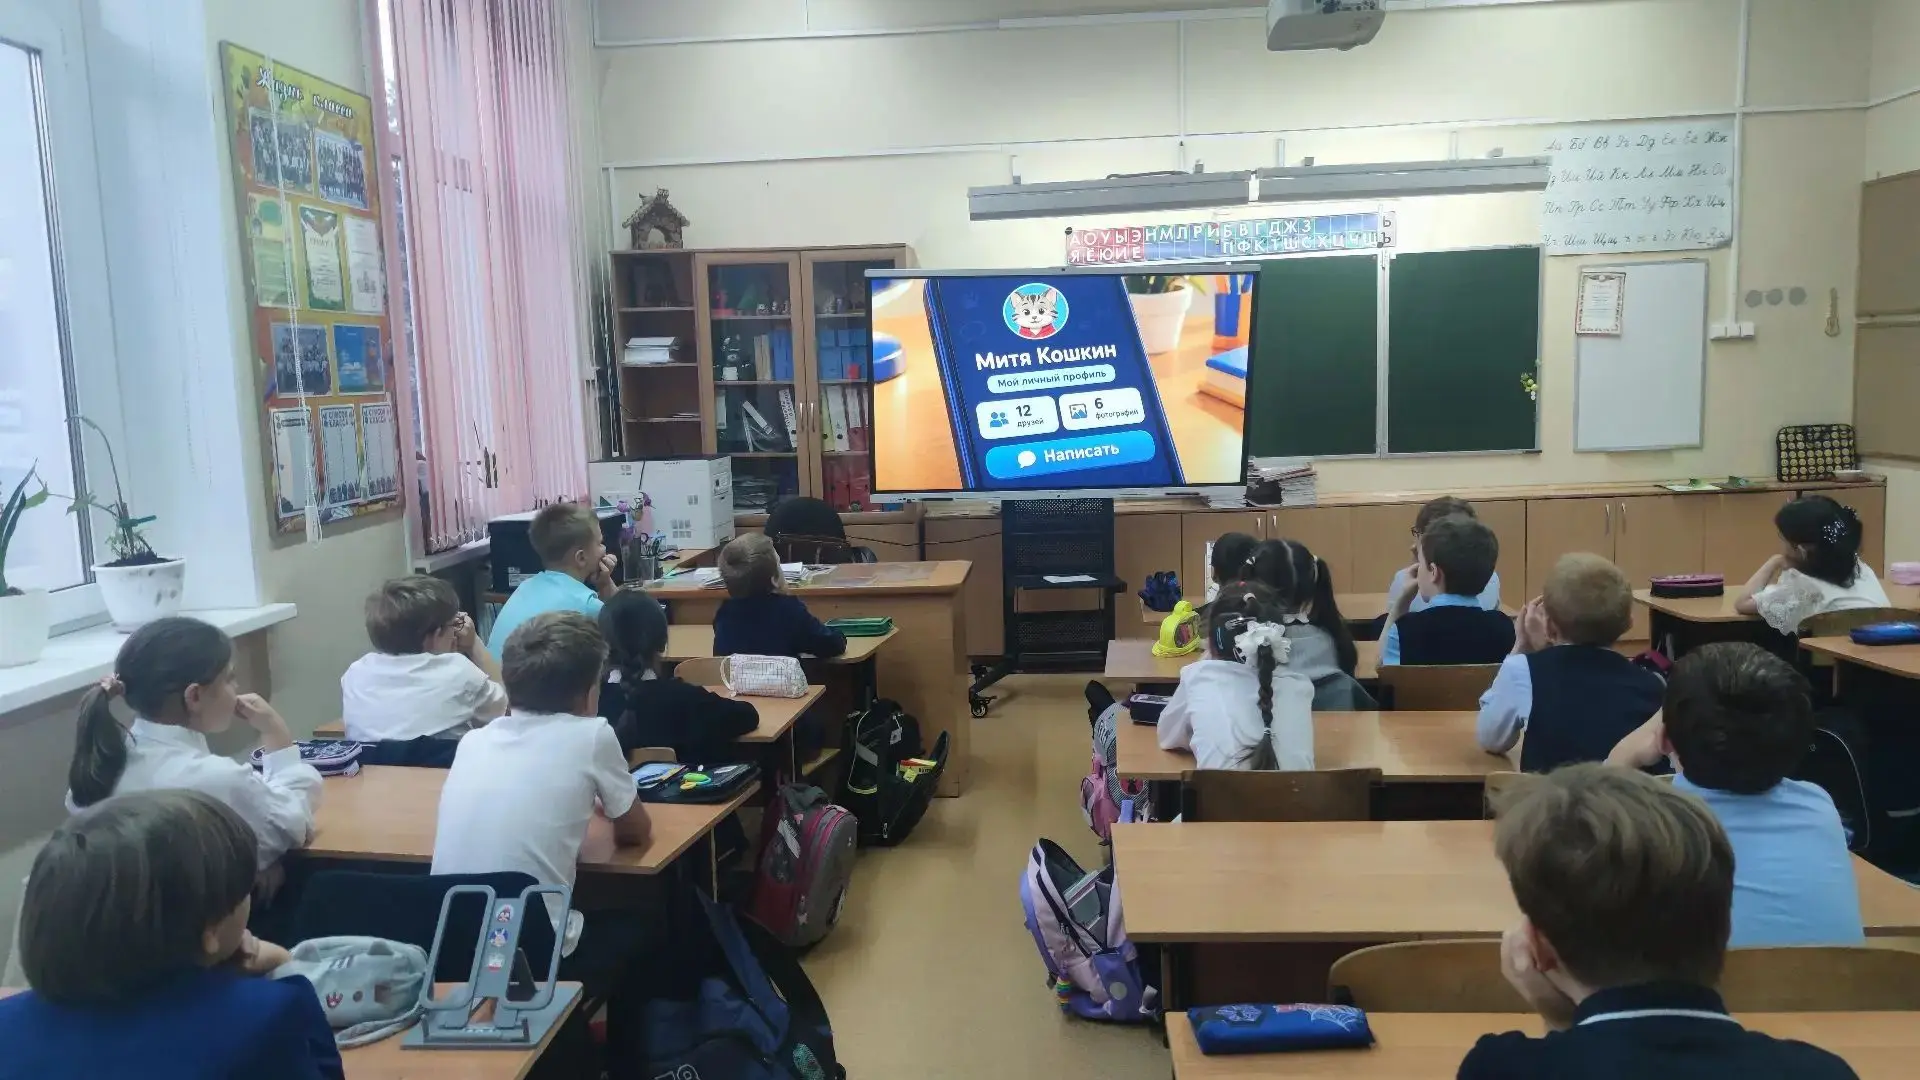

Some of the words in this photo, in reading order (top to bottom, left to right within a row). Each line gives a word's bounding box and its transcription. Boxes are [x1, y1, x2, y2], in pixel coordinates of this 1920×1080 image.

[1569, 135, 1590, 150] Бб
[1593, 134, 1611, 149] Вв
[1636, 134, 1655, 152] Дд
[1609, 166, 1630, 180] Кк
[1658, 164, 1683, 178] Мм
[1608, 197, 1636, 211] Тт
[975, 351, 1032, 371] Митя
[1036, 344, 1117, 365] Кошкин
[997, 377, 1019, 388] Мой
[1022, 373, 1061, 386] личный
[1063, 370, 1107, 383] профиль
[1015, 404, 1032, 417] 12
[1094, 397, 1104, 409] 6
[1017, 417, 1044, 428] друзей
[1043, 444, 1120, 463] Написать
